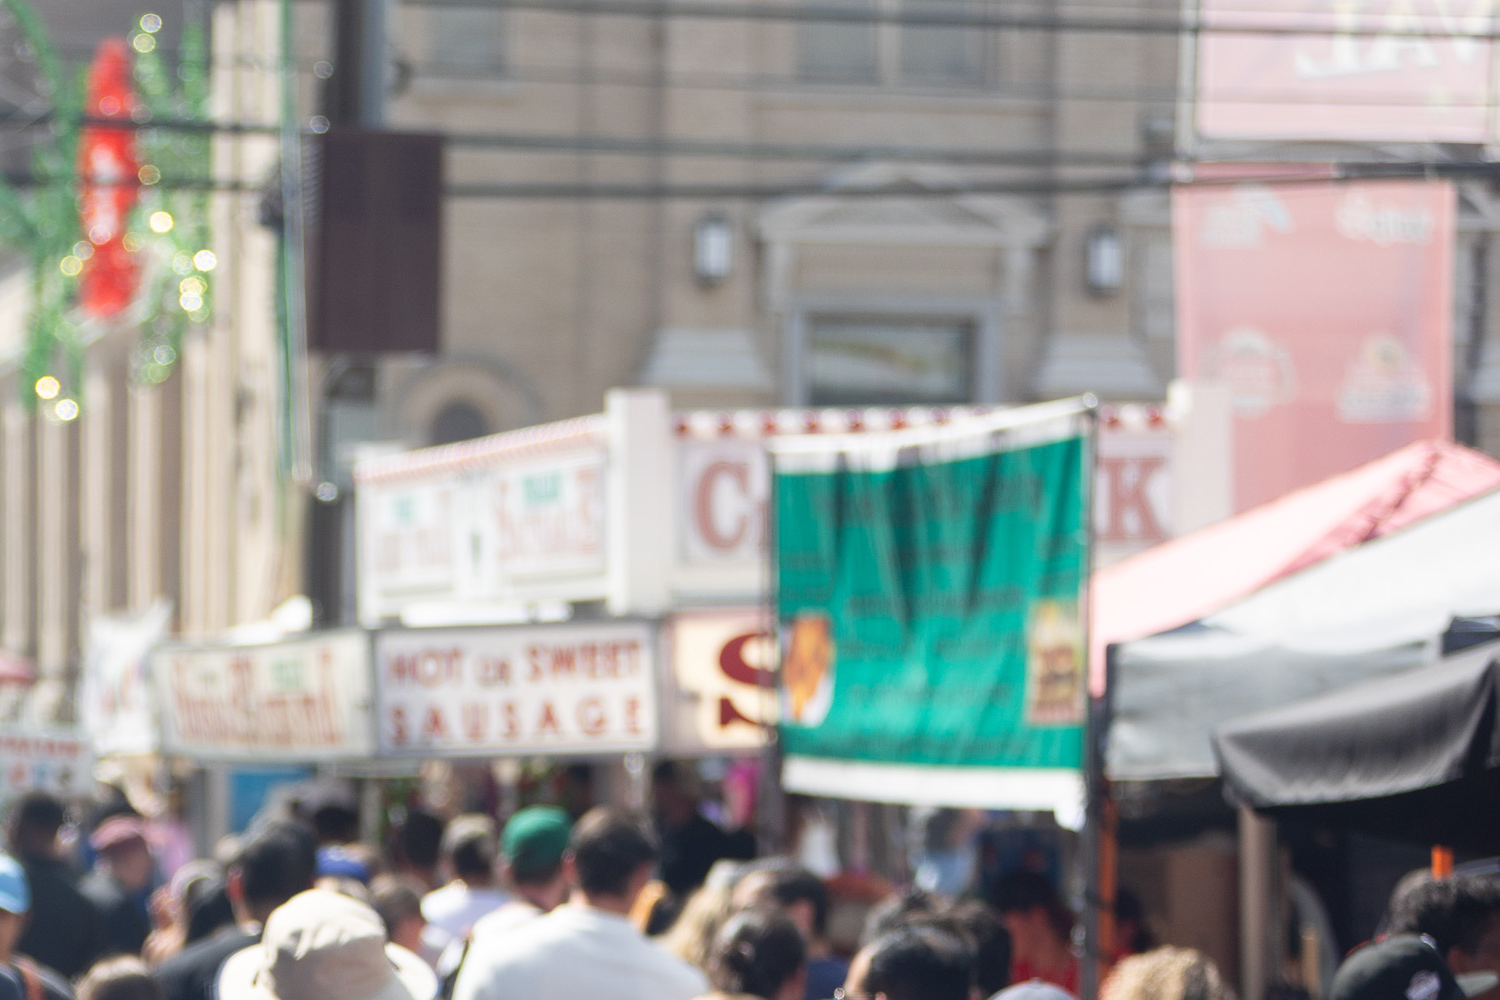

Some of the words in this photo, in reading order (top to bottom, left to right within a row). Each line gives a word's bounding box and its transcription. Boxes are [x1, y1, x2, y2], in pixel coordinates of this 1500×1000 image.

[389, 648, 463, 687] HOT
[525, 641, 641, 682] SWEET
[389, 697, 643, 745] SAUSAGE
